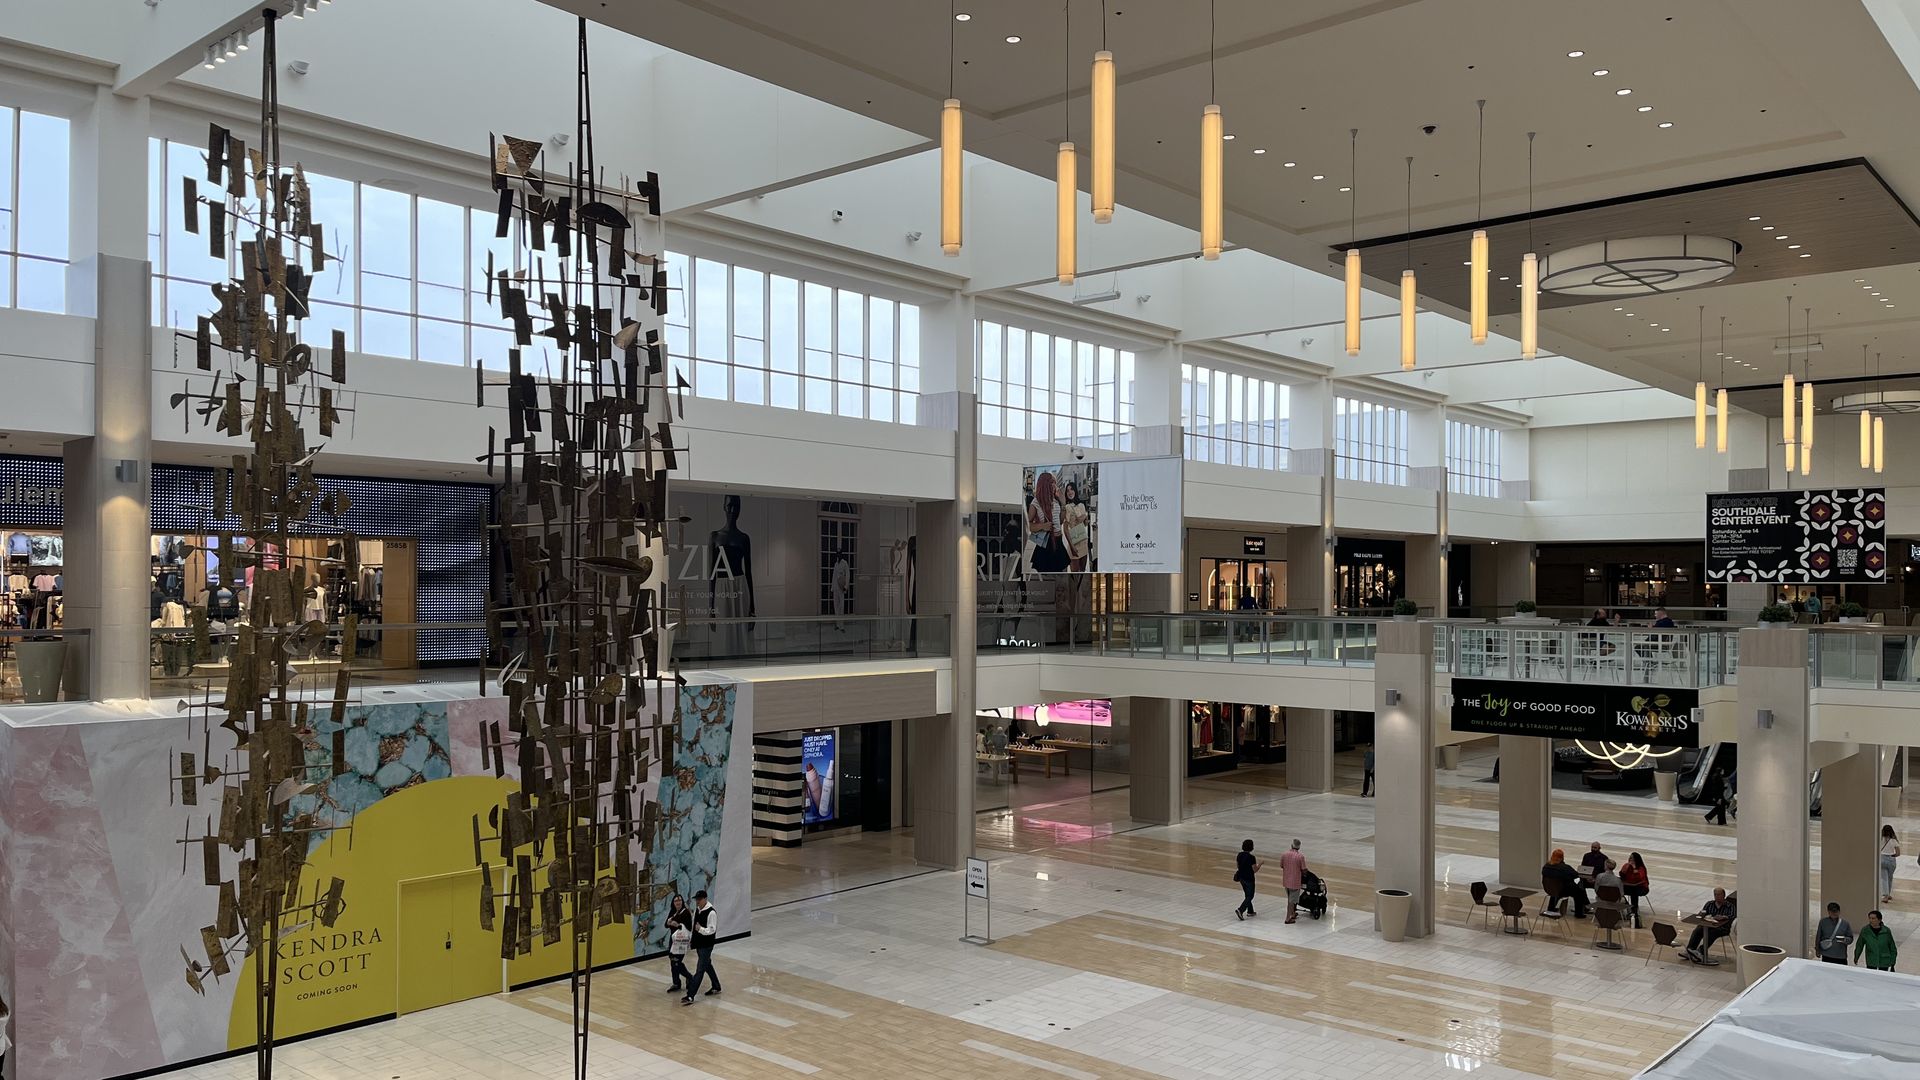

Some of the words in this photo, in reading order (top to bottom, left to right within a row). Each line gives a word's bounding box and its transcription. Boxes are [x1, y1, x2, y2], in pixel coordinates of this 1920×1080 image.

[1712, 506, 1776, 516] SOUTHDALE
[1712, 516, 1754, 526] CENTER
[1754, 515, 1791, 524] EVENT
[1120, 540, 1135, 548] kate
[1136, 541, 1156, 550] spade
[1462, 698, 1480, 708] THE
[1481, 693, 1511, 716] Joy
[1513, 701, 1527, 710] OF
[1529, 702, 1562, 712] GOOD
[1564, 704, 1596, 714] FOOD
[276, 928, 382, 960] KENDRA
[282, 953, 371, 985] SCOTT
[297, 988, 332, 1000] COMING
[335, 984, 358, 993] SOON
